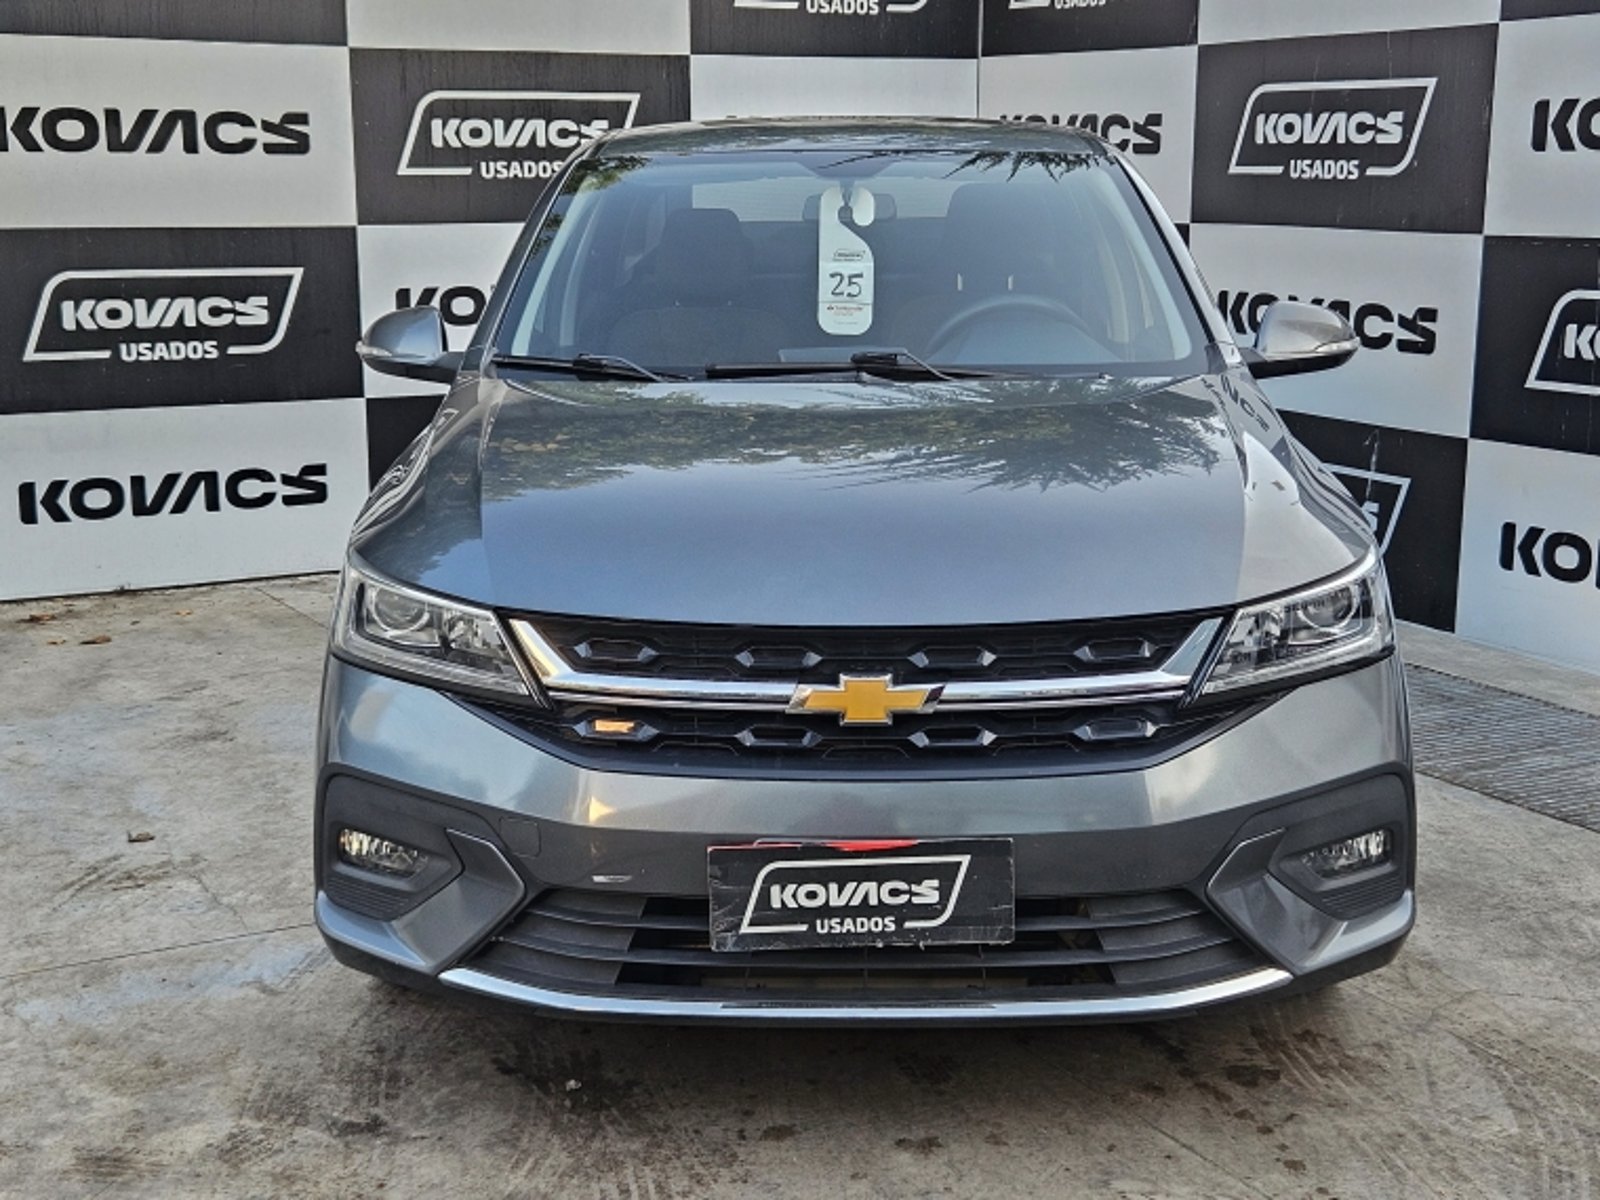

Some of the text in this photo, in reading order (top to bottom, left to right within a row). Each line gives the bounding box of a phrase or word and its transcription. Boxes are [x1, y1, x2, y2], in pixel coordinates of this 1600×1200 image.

[0, 106, 310, 155] KOVACS
[431, 118, 609, 149] KOVACS
[1255, 111, 1404, 145] KOVACS
[1290, 158, 1359, 180] USADOS
[829, 272, 864, 298] 25
[61, 296, 269, 331] KOVACS
[119, 340, 219, 362] USADOS
[18, 463, 328, 525] KOVACS
[770, 879, 940, 909] KOVACS
[815, 916, 896, 934] USADOS
